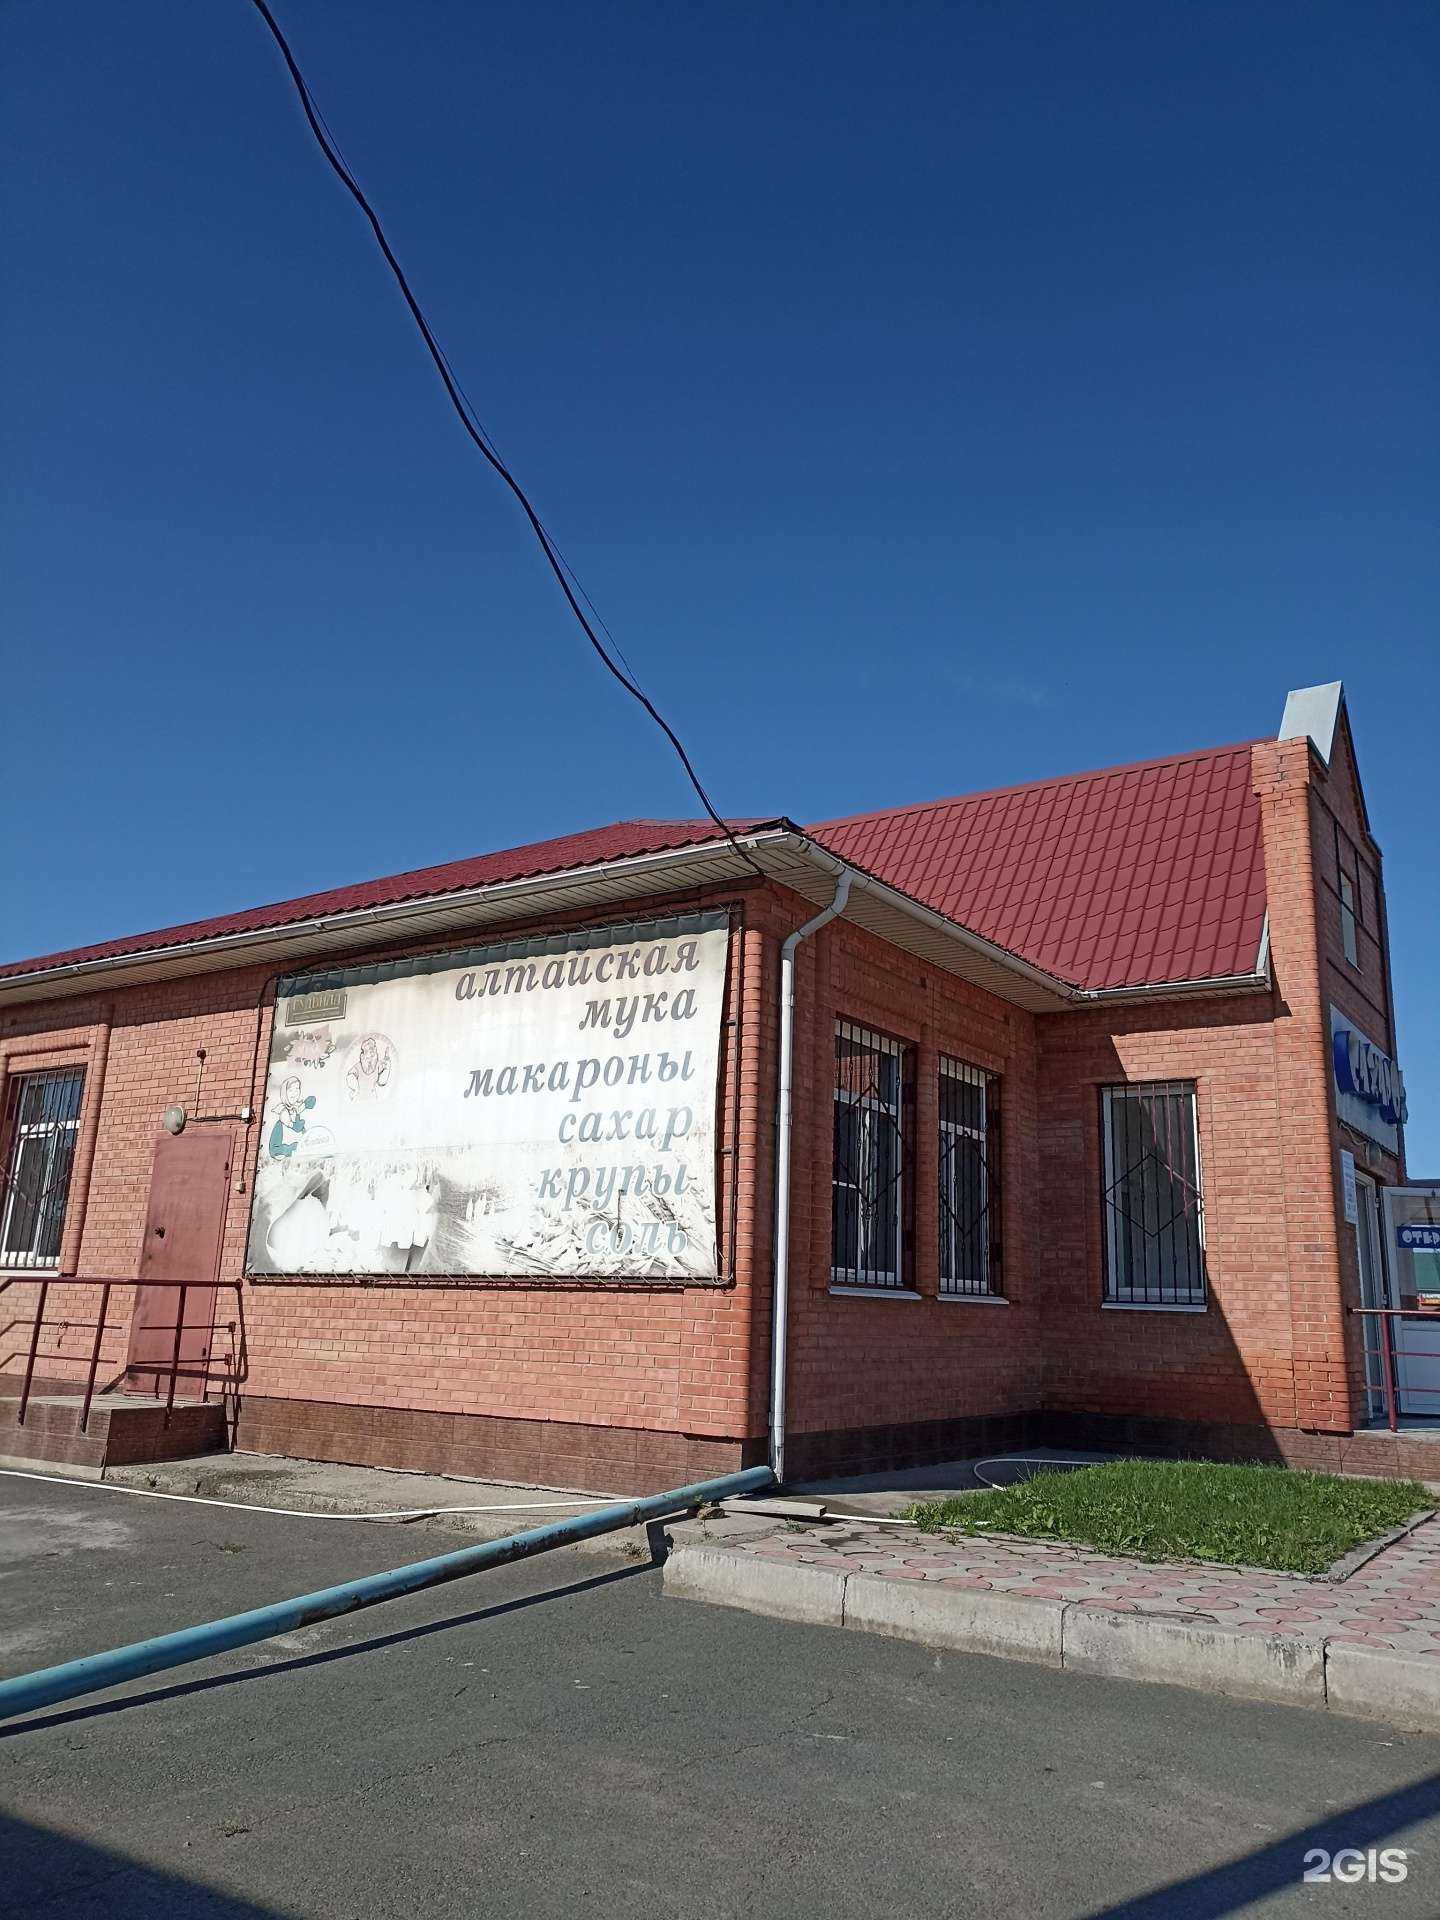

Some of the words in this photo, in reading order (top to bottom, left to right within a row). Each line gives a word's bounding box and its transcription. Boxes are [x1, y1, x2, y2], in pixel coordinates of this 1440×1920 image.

[455, 941, 700, 1000] алтайская
[578, 989, 698, 1039] мука
[463, 1051, 695, 1102] макароны
[558, 1105, 694, 1152] сахар
[538, 1164, 690, 1212] крупы
[585, 1222, 688, 1255] соль
